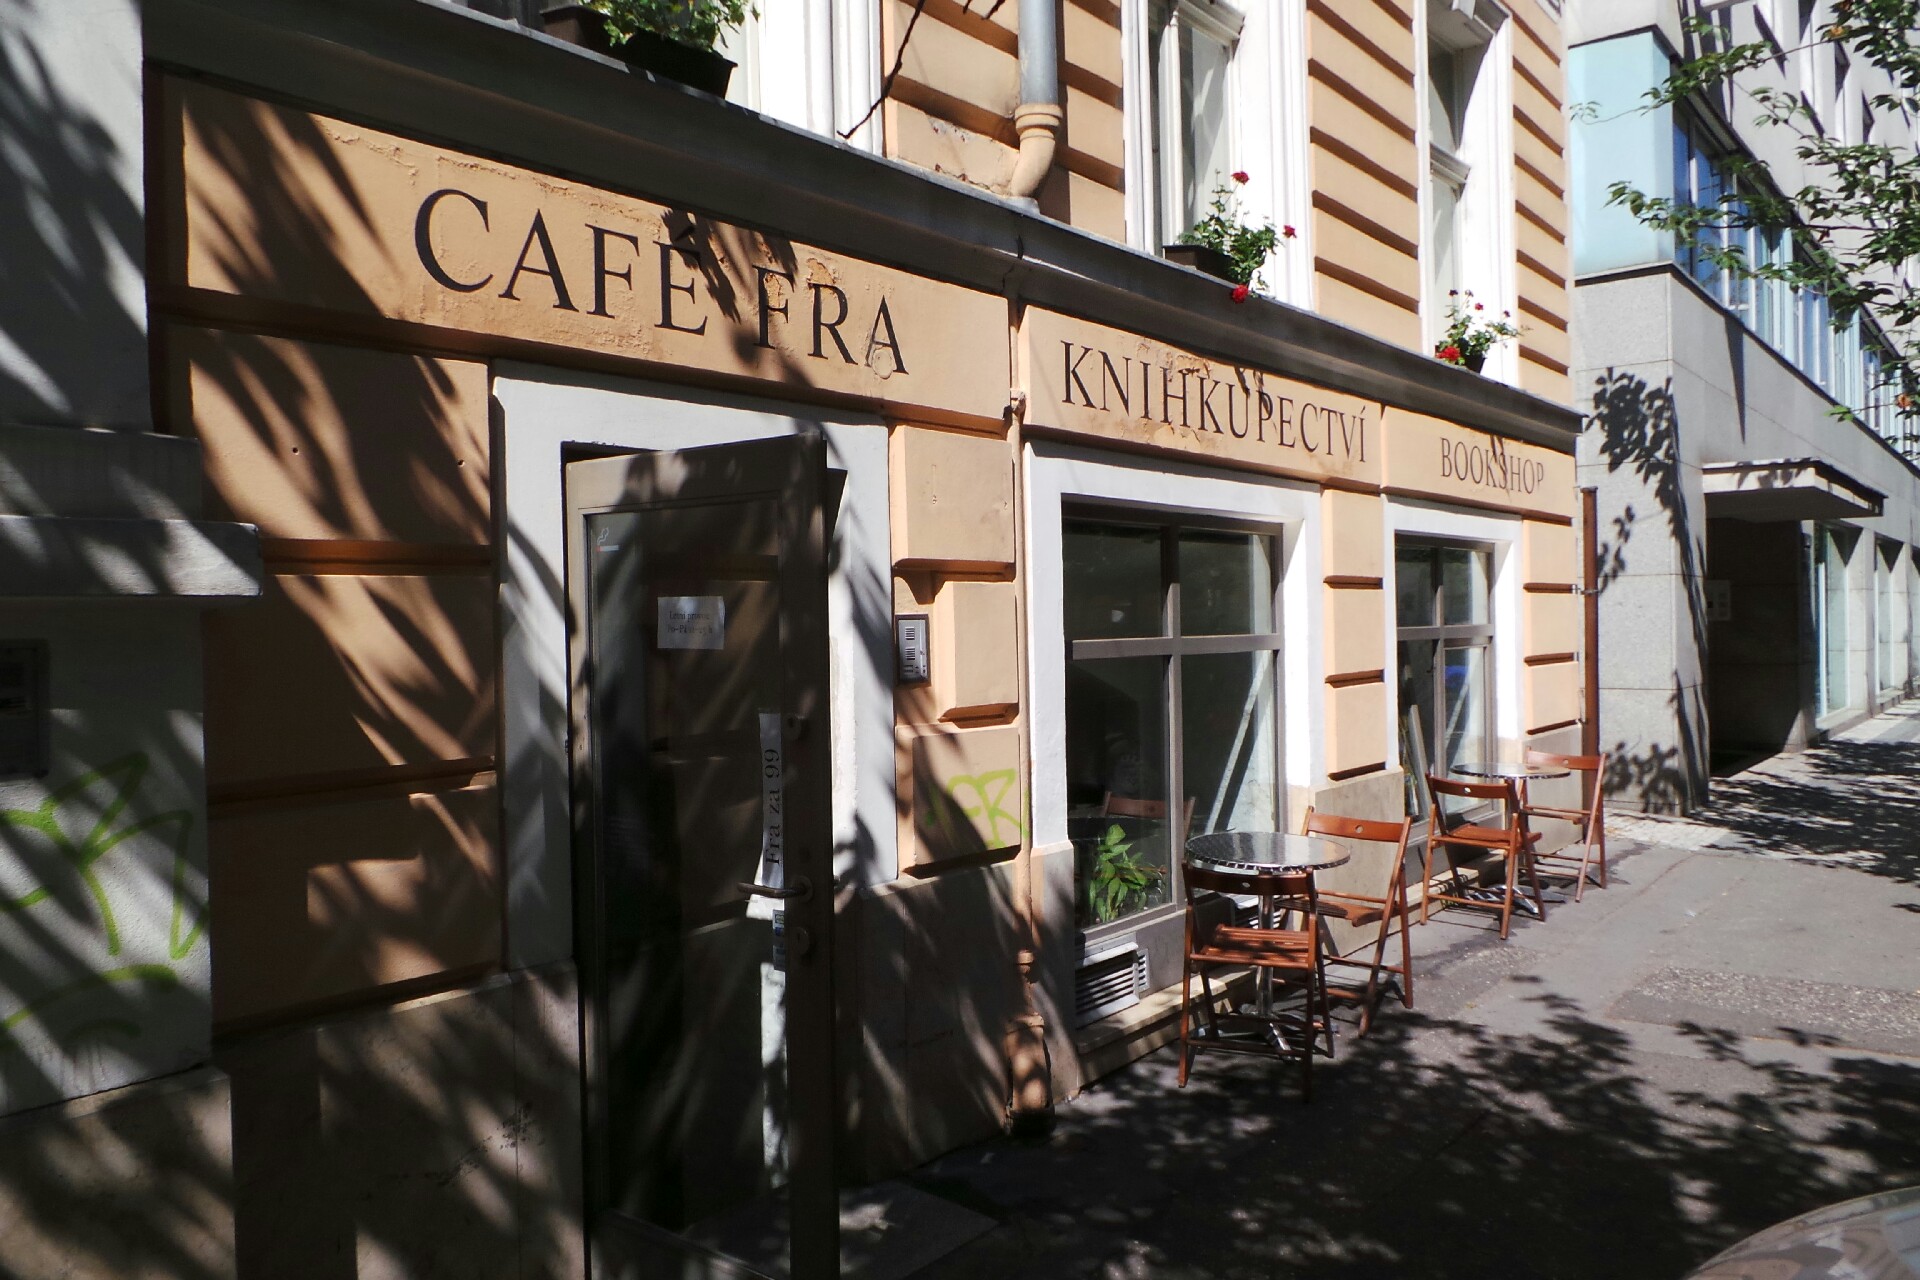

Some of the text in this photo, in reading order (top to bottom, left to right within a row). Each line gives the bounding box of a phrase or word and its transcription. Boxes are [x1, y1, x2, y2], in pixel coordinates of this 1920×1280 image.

[415, 188, 910, 376] CAFÉ FRA
[1060, 339, 1367, 464] KNIHKUPECTVÍ
[1440, 437, 1545, 496] BOOKSHOP
[764, 748, 780, 865] Fra za 99
